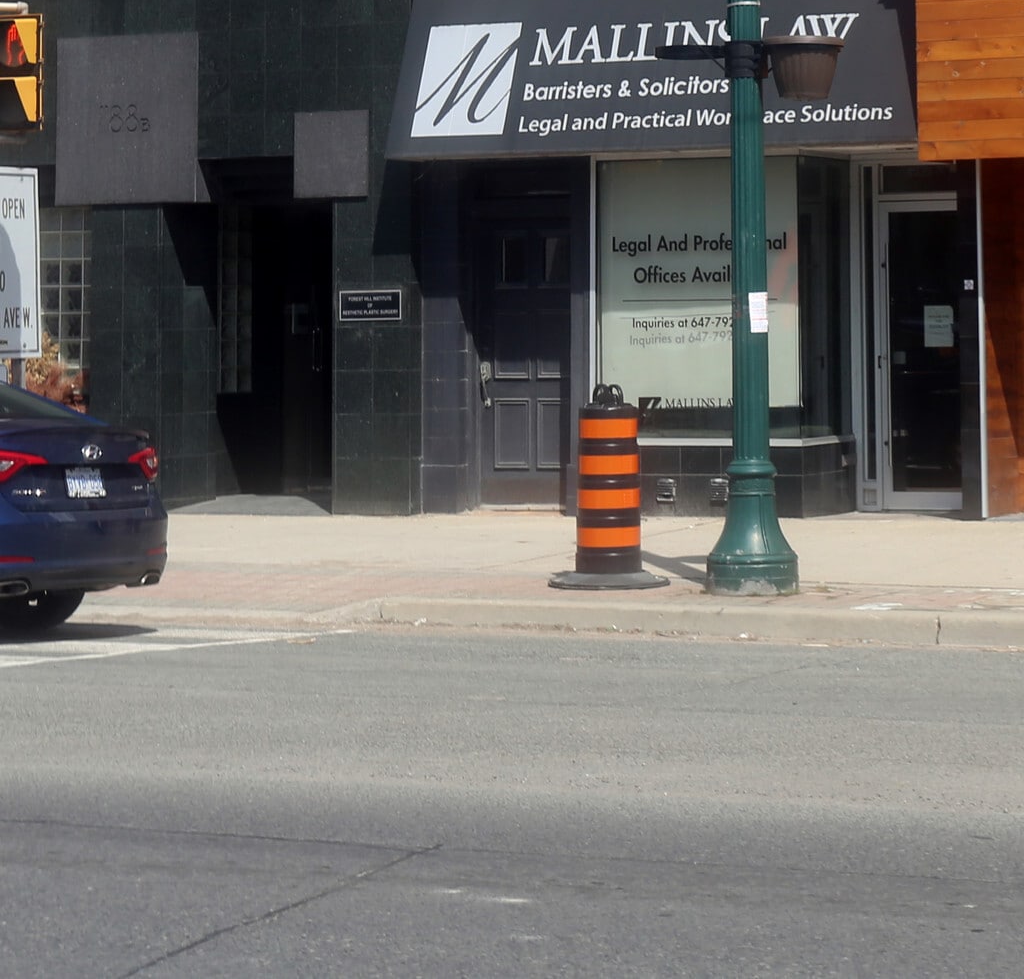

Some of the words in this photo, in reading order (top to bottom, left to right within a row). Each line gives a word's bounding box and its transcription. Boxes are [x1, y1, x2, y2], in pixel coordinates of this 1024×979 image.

[523, 80, 612, 101] Barristers
[618, 79, 631, 98] &
[638, 76, 730, 97] Solicitors
[518, 113, 568, 137] Legal
[571, 112, 608, 131] and
[612, 109, 692, 130] Practical
[697, 108, 796, 127] Worace
[800, 104, 893, 123] Solutions
[2, 198, 25, 219] OPEN
[612, 234, 651, 257] Legal
[657, 233, 688, 252] And
[694, 232, 787, 251] Profenal
[634, 265, 686, 284] Offices
[692, 264, 731, 283] Avail
[4, 307, 20, 328] AVE
[23, 307, 33, 328] W.
[632, 317, 675, 331] Inquiries
[678, 318, 688, 328] at
[665, 397, 715, 407] MALLINS
